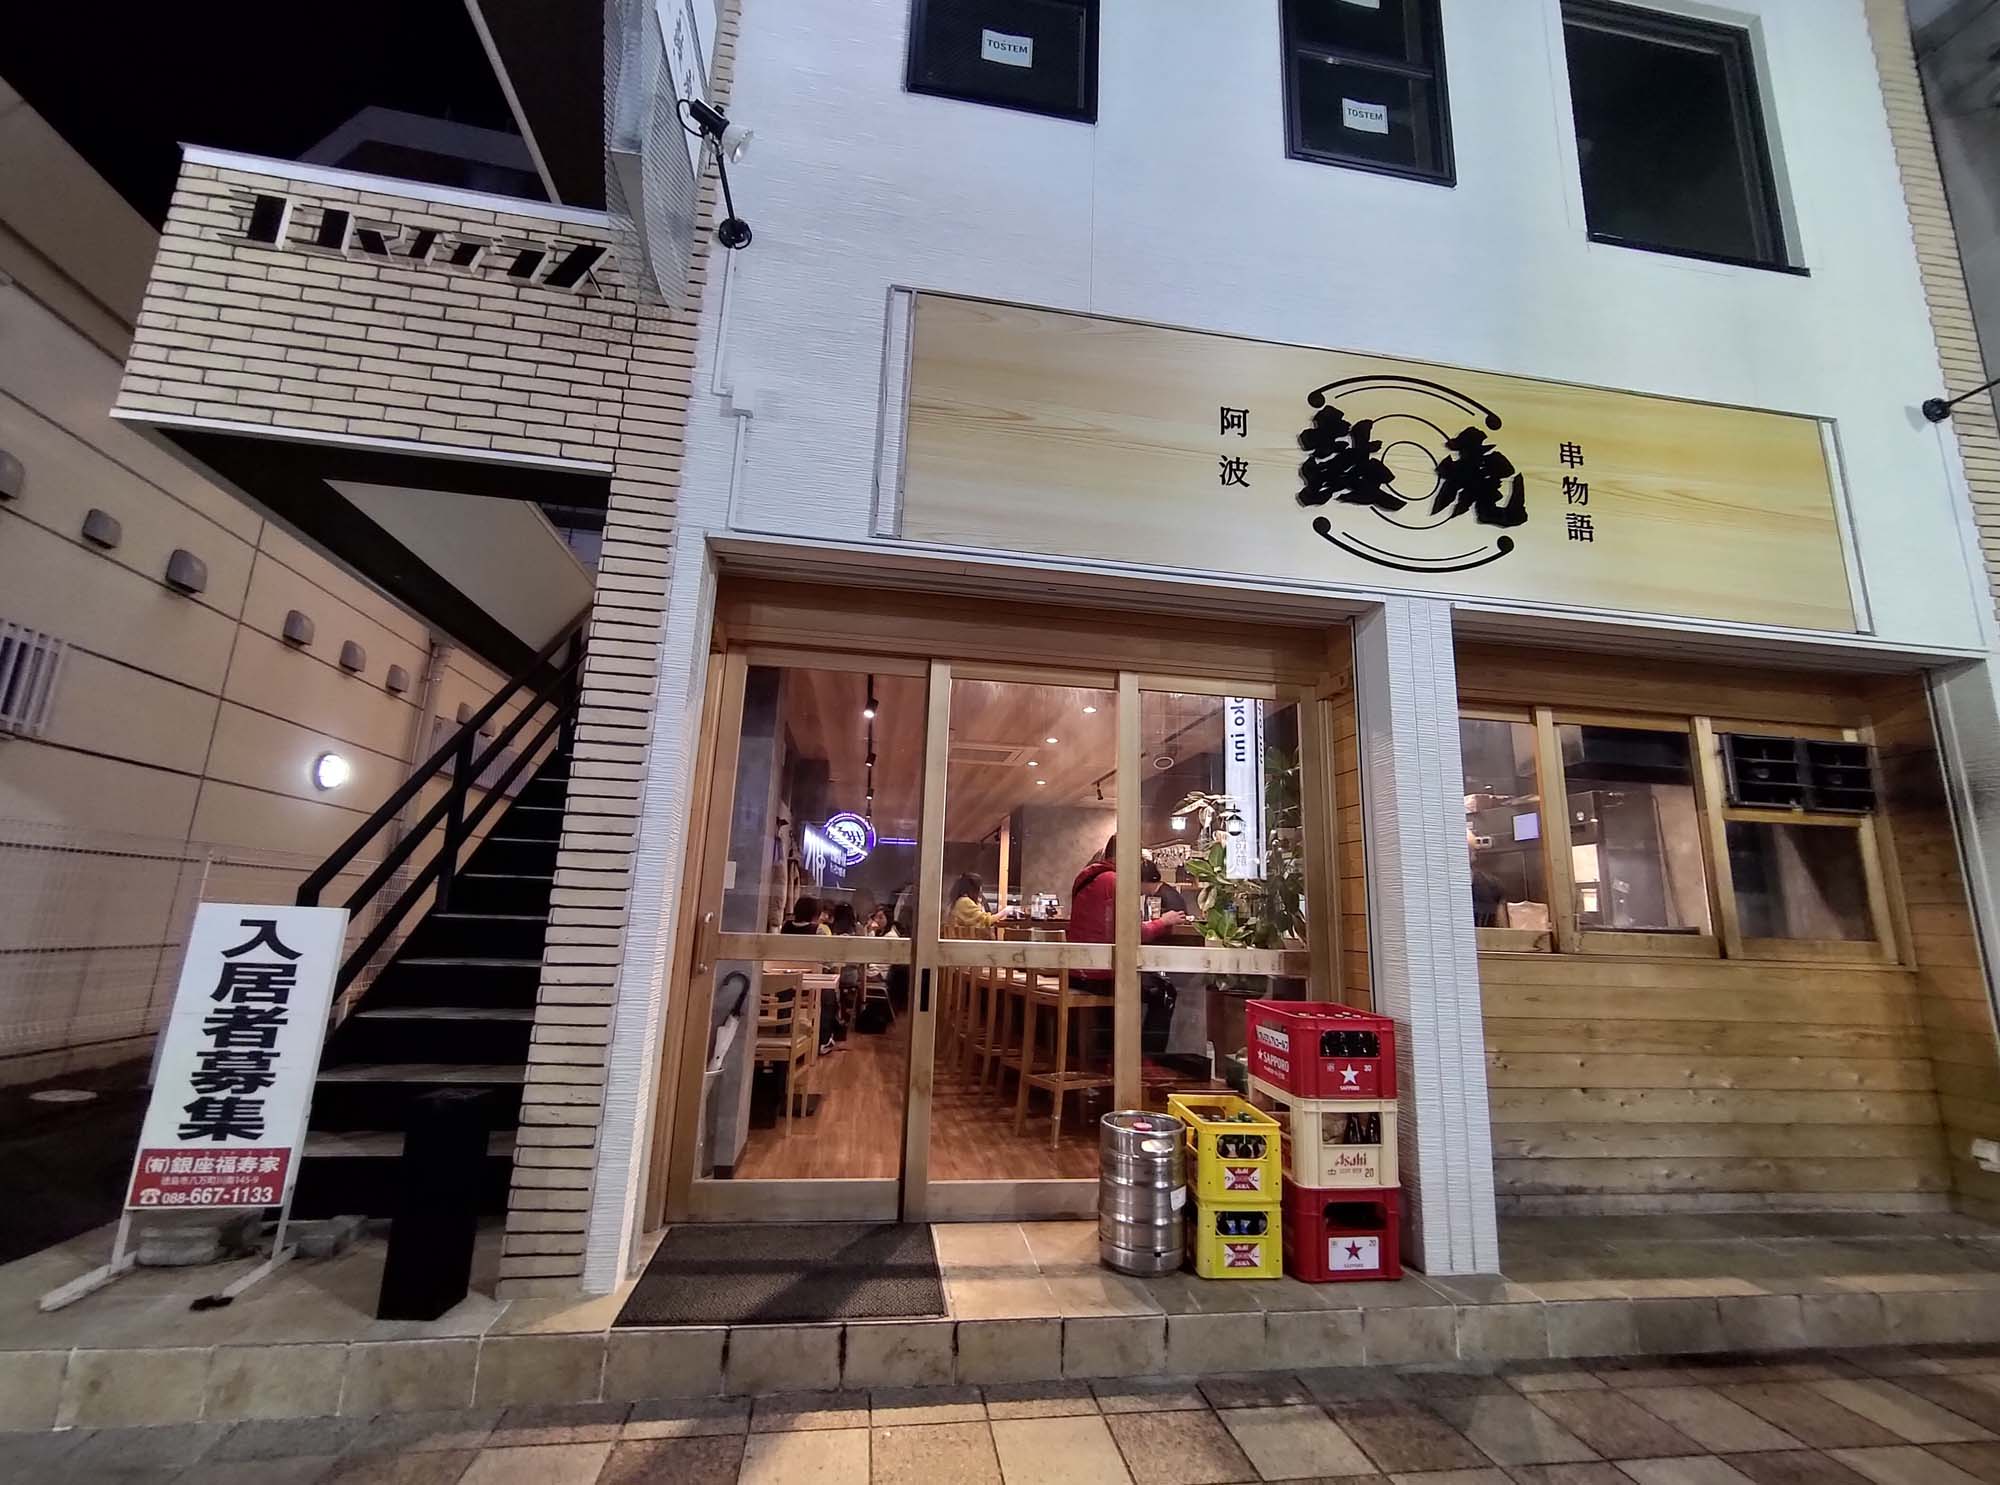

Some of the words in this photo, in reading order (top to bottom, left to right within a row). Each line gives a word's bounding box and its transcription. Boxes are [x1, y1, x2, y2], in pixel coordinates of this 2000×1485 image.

[986, 38, 1028, 55] TOSTEM
[1347, 106, 1384, 123] TOSTEM
[1219, 405, 1250, 488] 阿波
[1558, 440, 1595, 543] 串物語
[176, 918, 304, 1142] 入居者募集
[1263, 1051, 1290, 1073] SAPPORO
[1334, 1151, 1367, 1167] Asahi
[1364, 1167, 1375, 1178] 20
[162, 1186, 273, 1206] 088-667-1133
